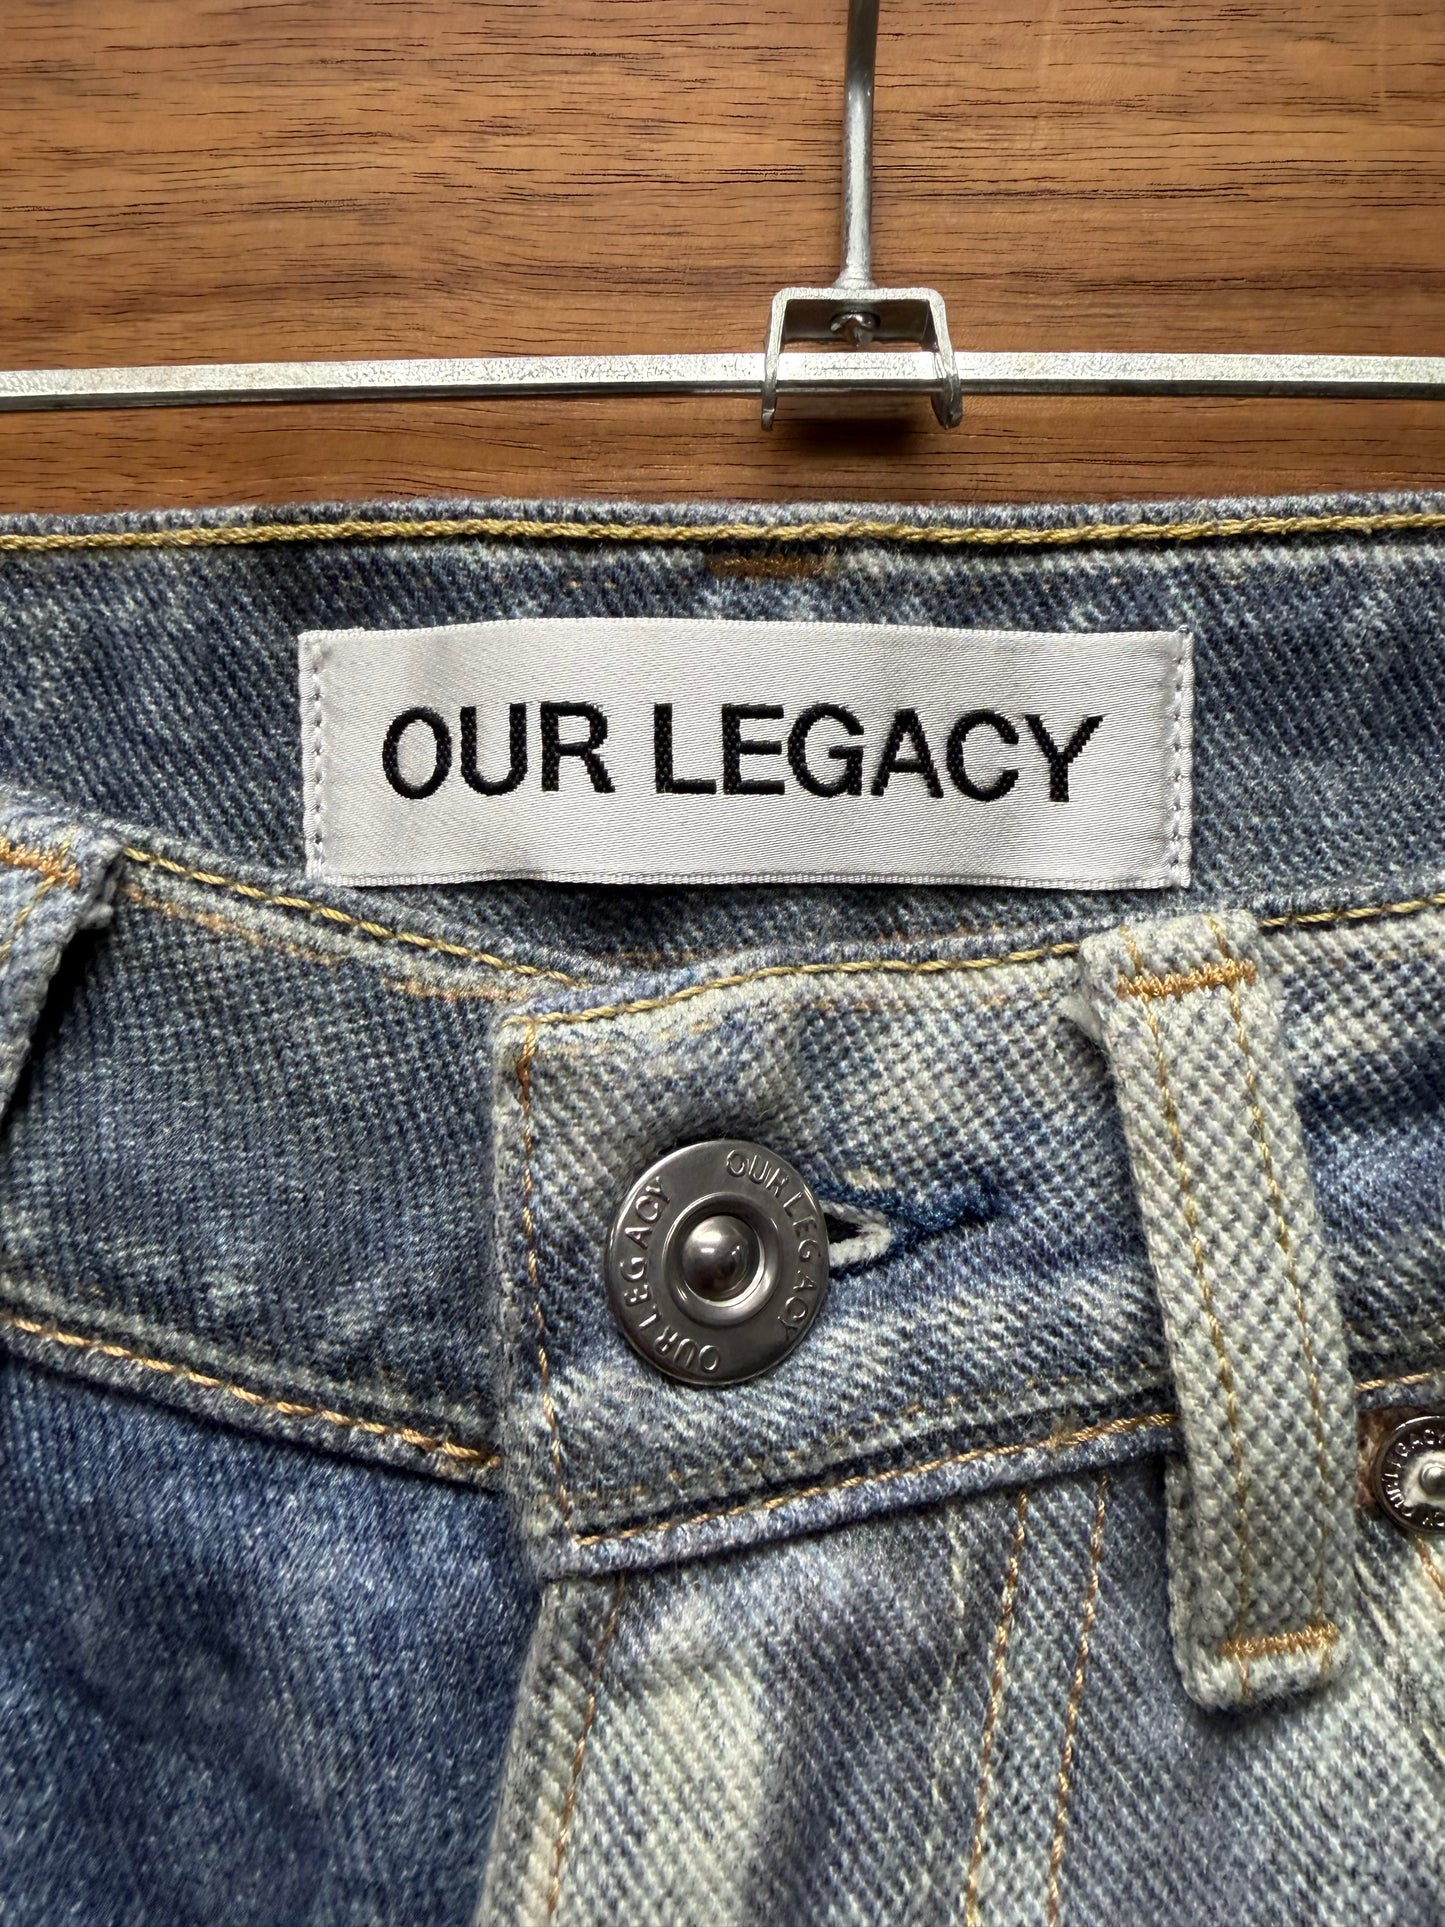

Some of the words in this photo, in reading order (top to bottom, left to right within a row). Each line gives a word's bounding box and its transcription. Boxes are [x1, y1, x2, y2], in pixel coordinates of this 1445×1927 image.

[381, 700, 616, 800] OUR
[653, 702, 1104, 803] LEGACY
[619, 1175, 670, 1331] LEGACY
[726, 1149, 790, 1198] OUR
[777, 1191, 822, 1341] LEGACY
[653, 1324, 721, 1374] OUR
